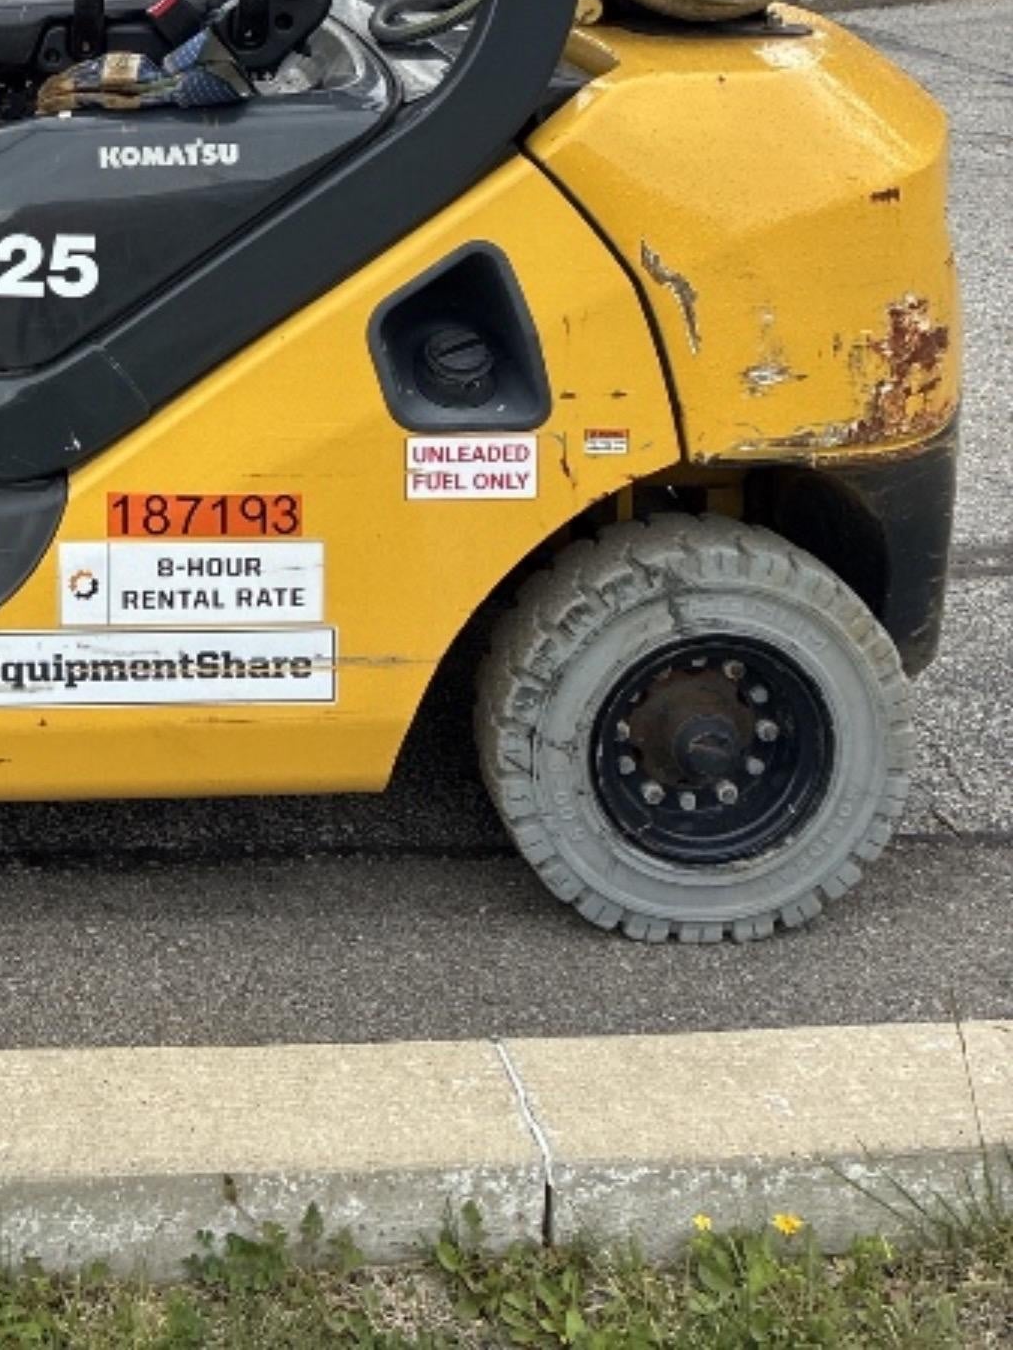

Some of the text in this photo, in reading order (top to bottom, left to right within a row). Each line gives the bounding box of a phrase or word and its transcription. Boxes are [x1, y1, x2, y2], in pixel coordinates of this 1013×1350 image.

[98, 138, 240, 170] KOMATSU
[412, 443, 530, 463] UNLEADED
[412, 472, 530, 491] FUEL ONLY
[112, 494, 300, 536] 187193
[157, 557, 262, 577] 8-HOUR
[121, 588, 305, 610] RENTAL RATE
